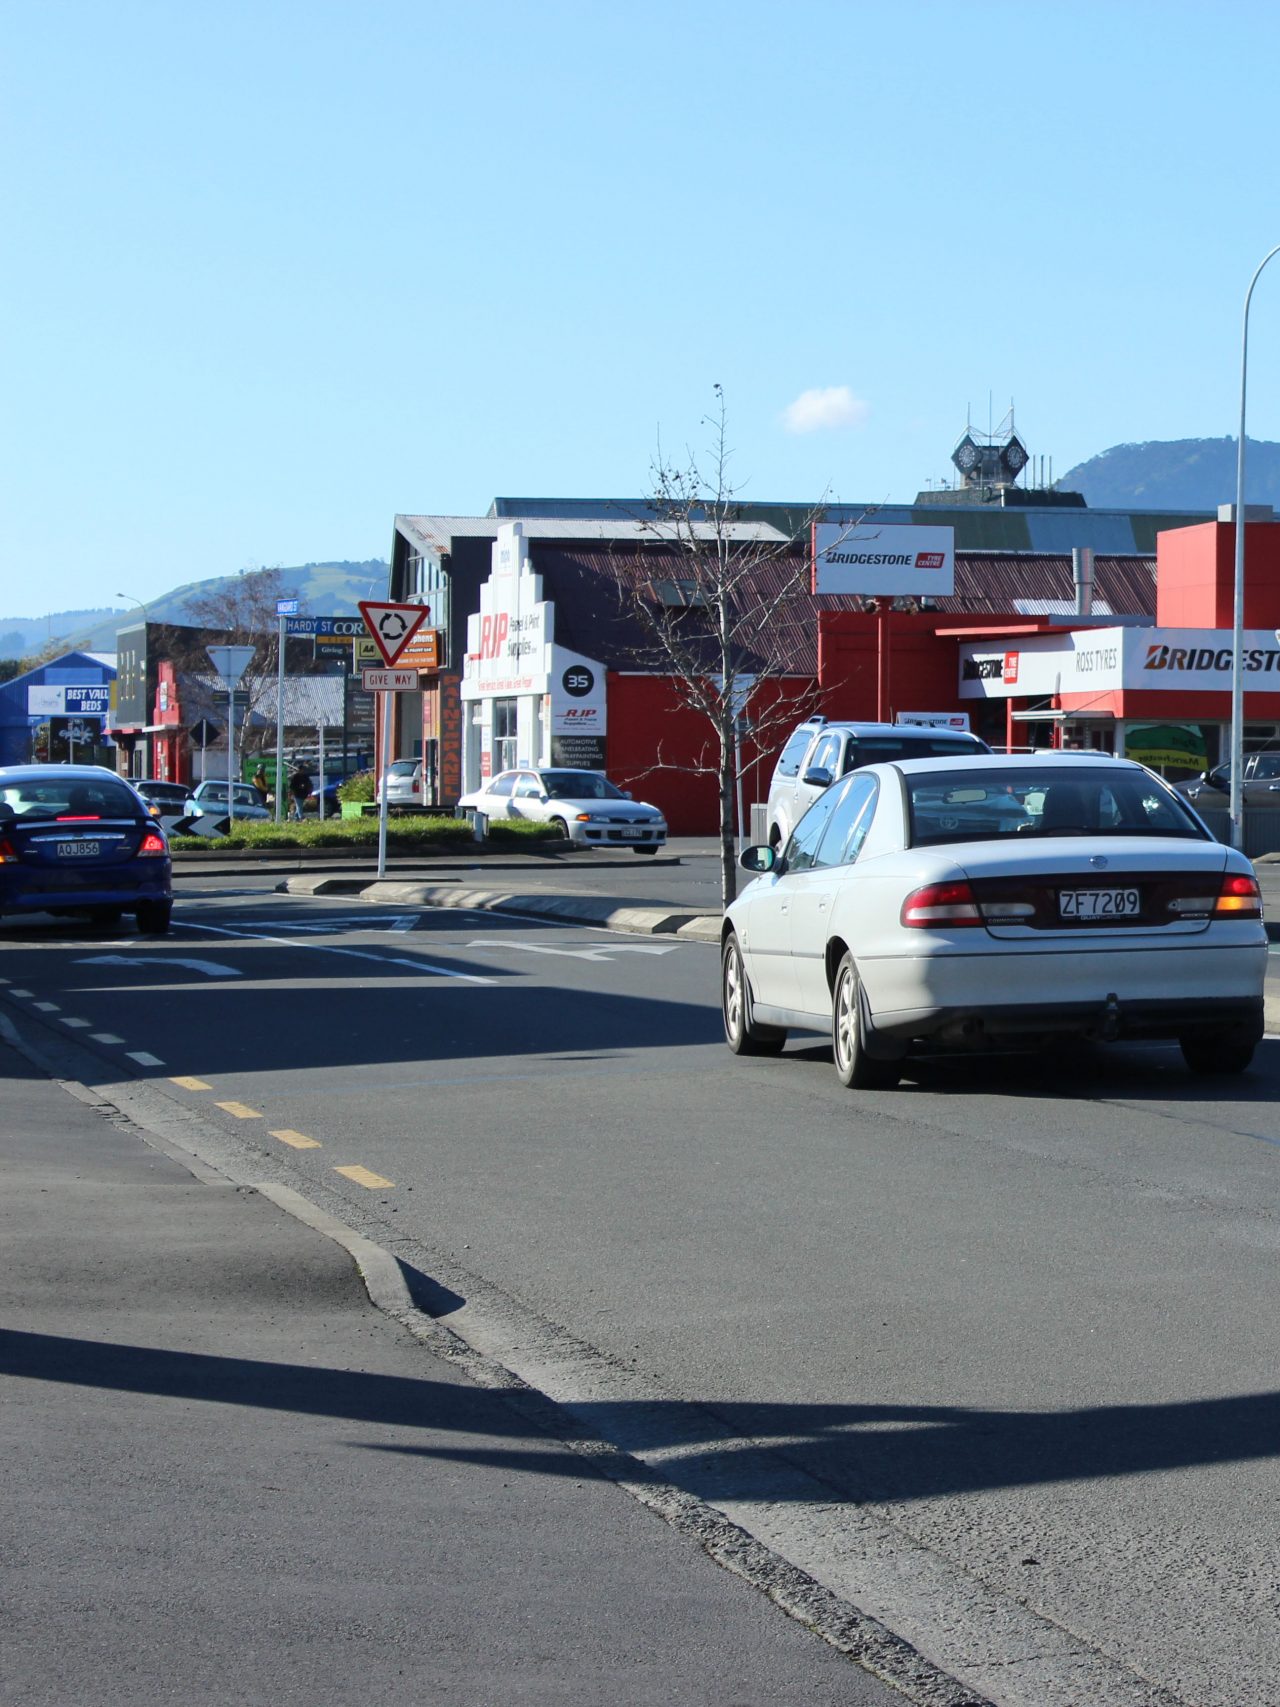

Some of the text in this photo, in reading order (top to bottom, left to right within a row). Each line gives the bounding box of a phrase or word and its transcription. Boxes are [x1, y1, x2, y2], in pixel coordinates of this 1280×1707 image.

[825, 551, 912, 566] BRIDGESTONE
[287, 620, 332, 632] HARDY ST
[362, 645, 374, 653] AA
[1076, 648, 1117, 673] ROSS TYRES
[369, 674, 388, 685] GIVE
[394, 674, 412, 685] WAY
[567, 674, 589, 688] 35
[67, 689, 87, 700] BEST
[80, 700, 102, 711] BEDS
[566, 708, 597, 718] RJP
[58, 842, 99, 857] AQJ856
[1061, 891, 1139, 915] ZF7209
